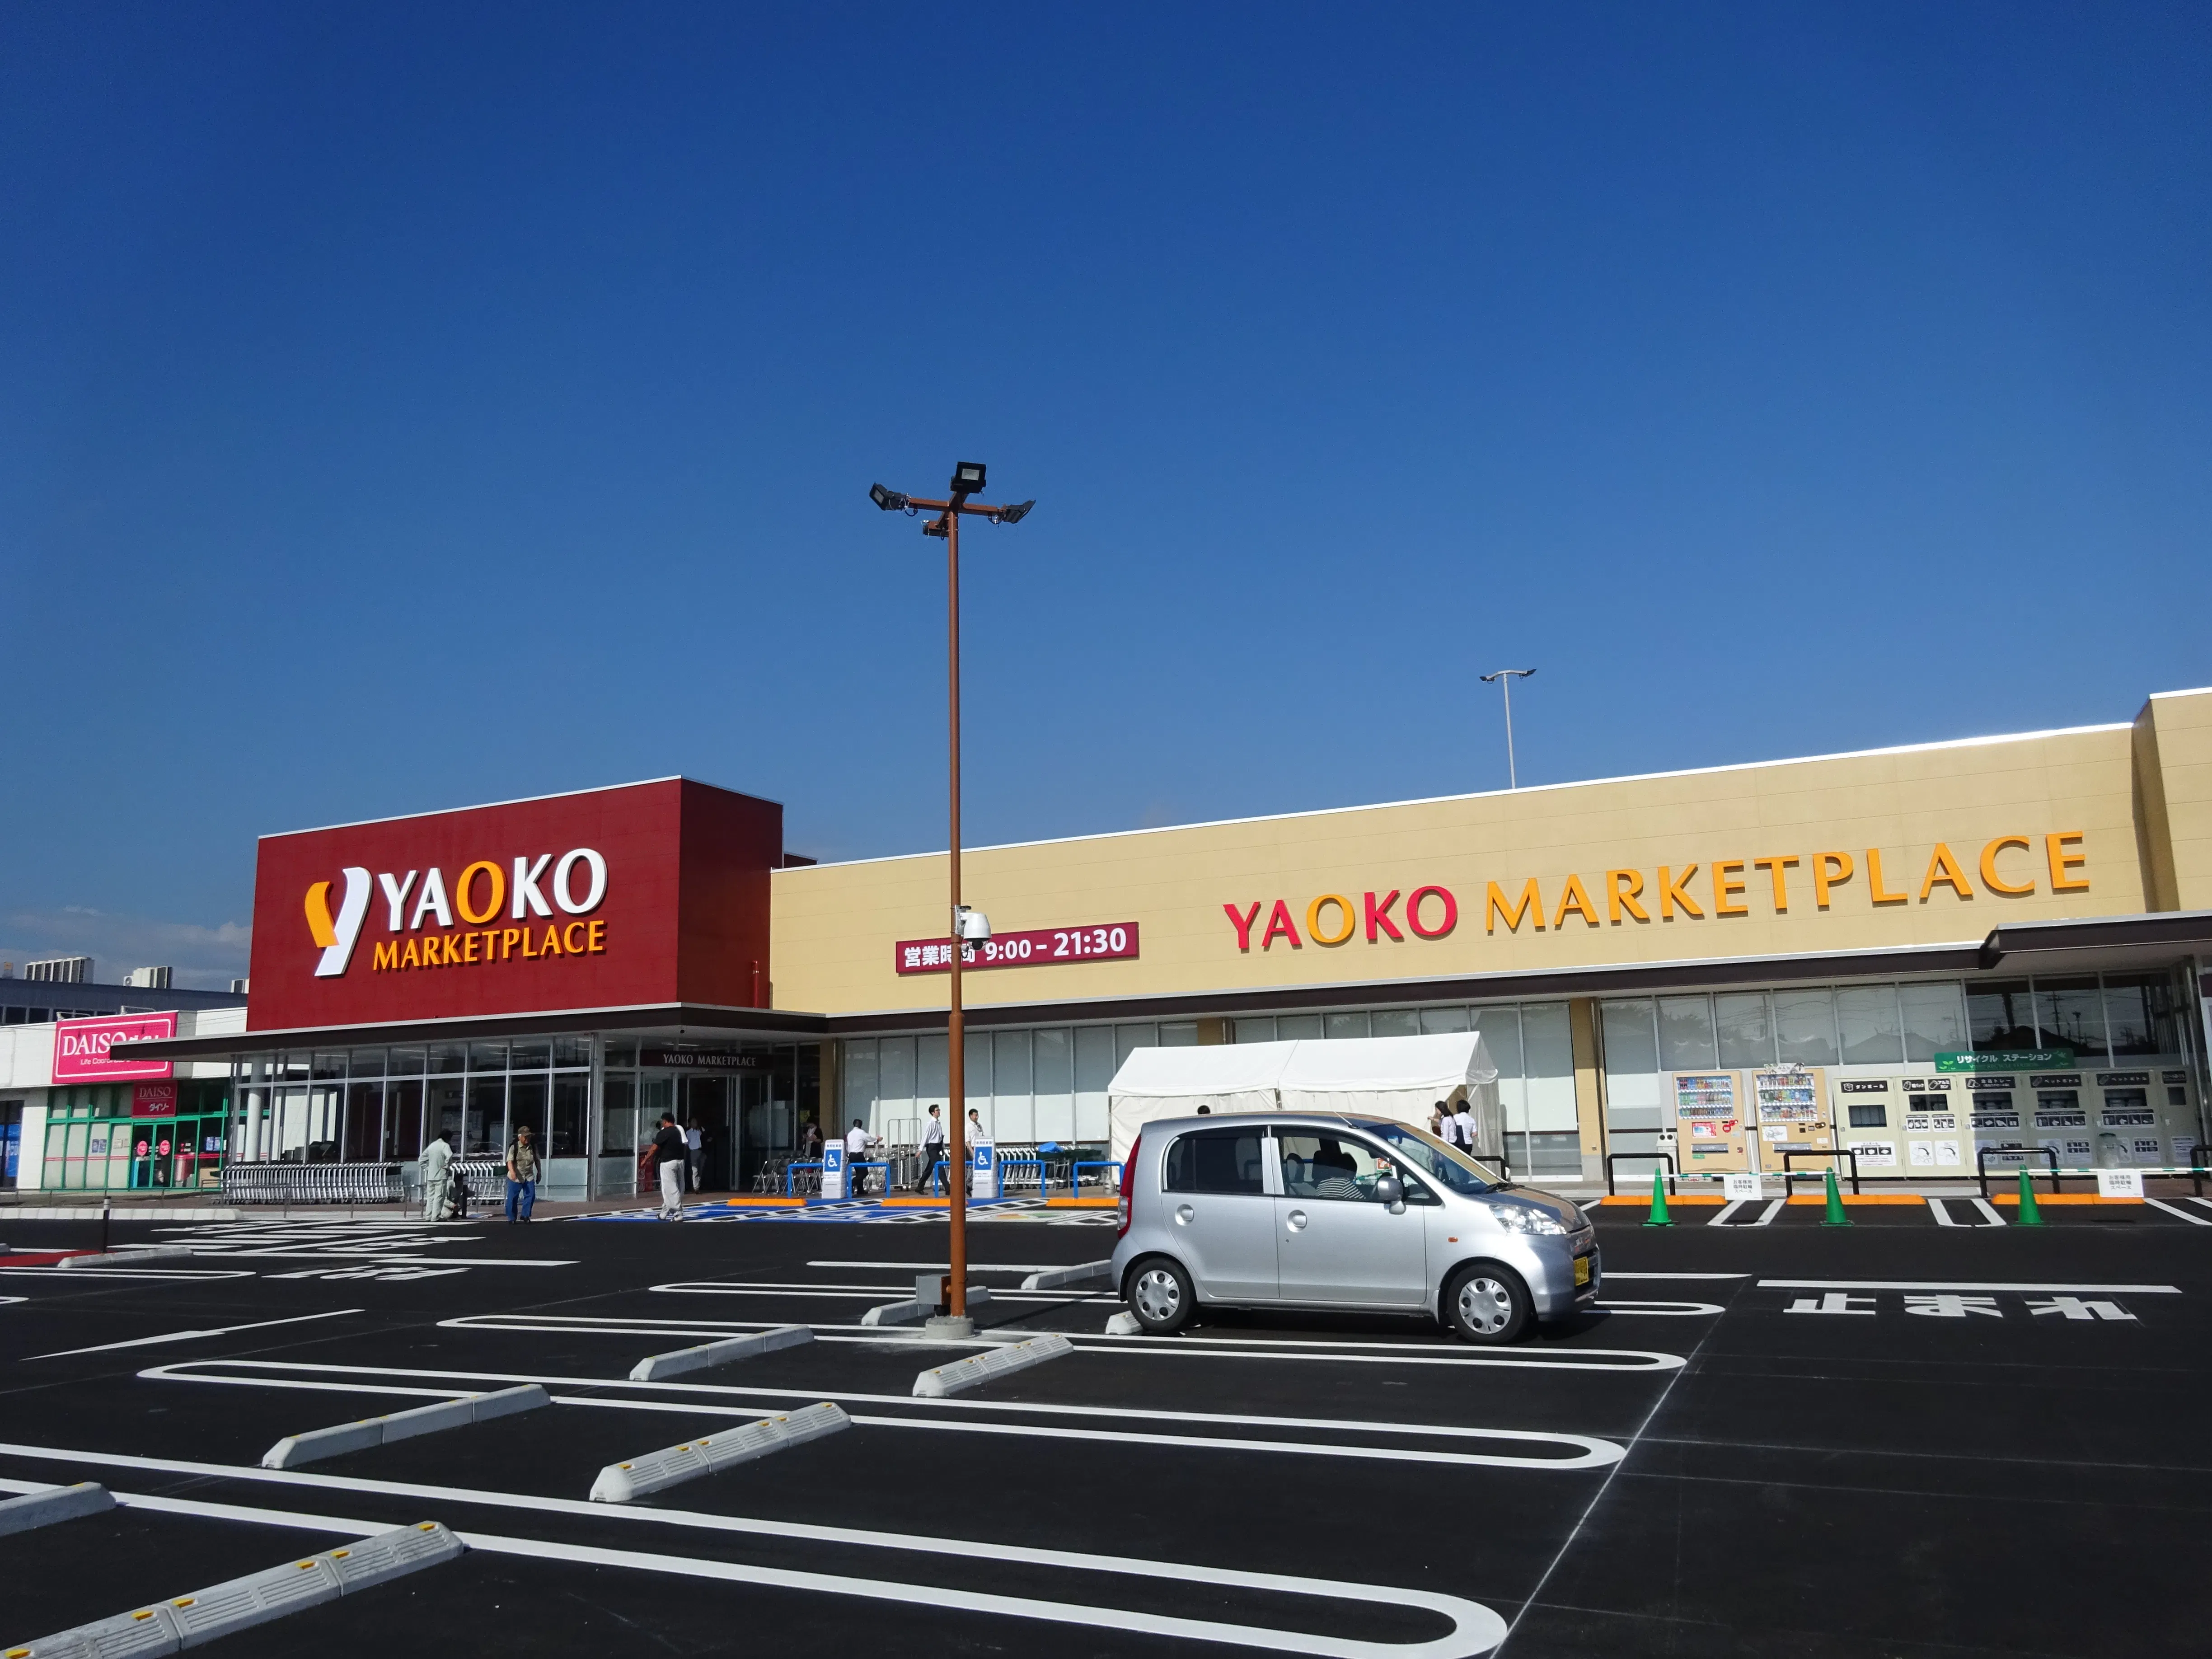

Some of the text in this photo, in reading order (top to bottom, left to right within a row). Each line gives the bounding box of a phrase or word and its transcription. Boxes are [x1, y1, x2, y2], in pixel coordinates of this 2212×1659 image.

[379, 848, 608, 931] YAOKO
[1225, 832, 2089, 949] YAOKO MARKETPLACE
[373, 920, 606, 971] MARKETPLACE
[663, 1054, 756, 1066] YAOKO MARKETPLACE
[1957, 1054, 2052, 1064] リサイクル ステーション
[140, 1086, 171, 1097] DAISO
[1783, 1293, 2138, 1320] 止まれ
